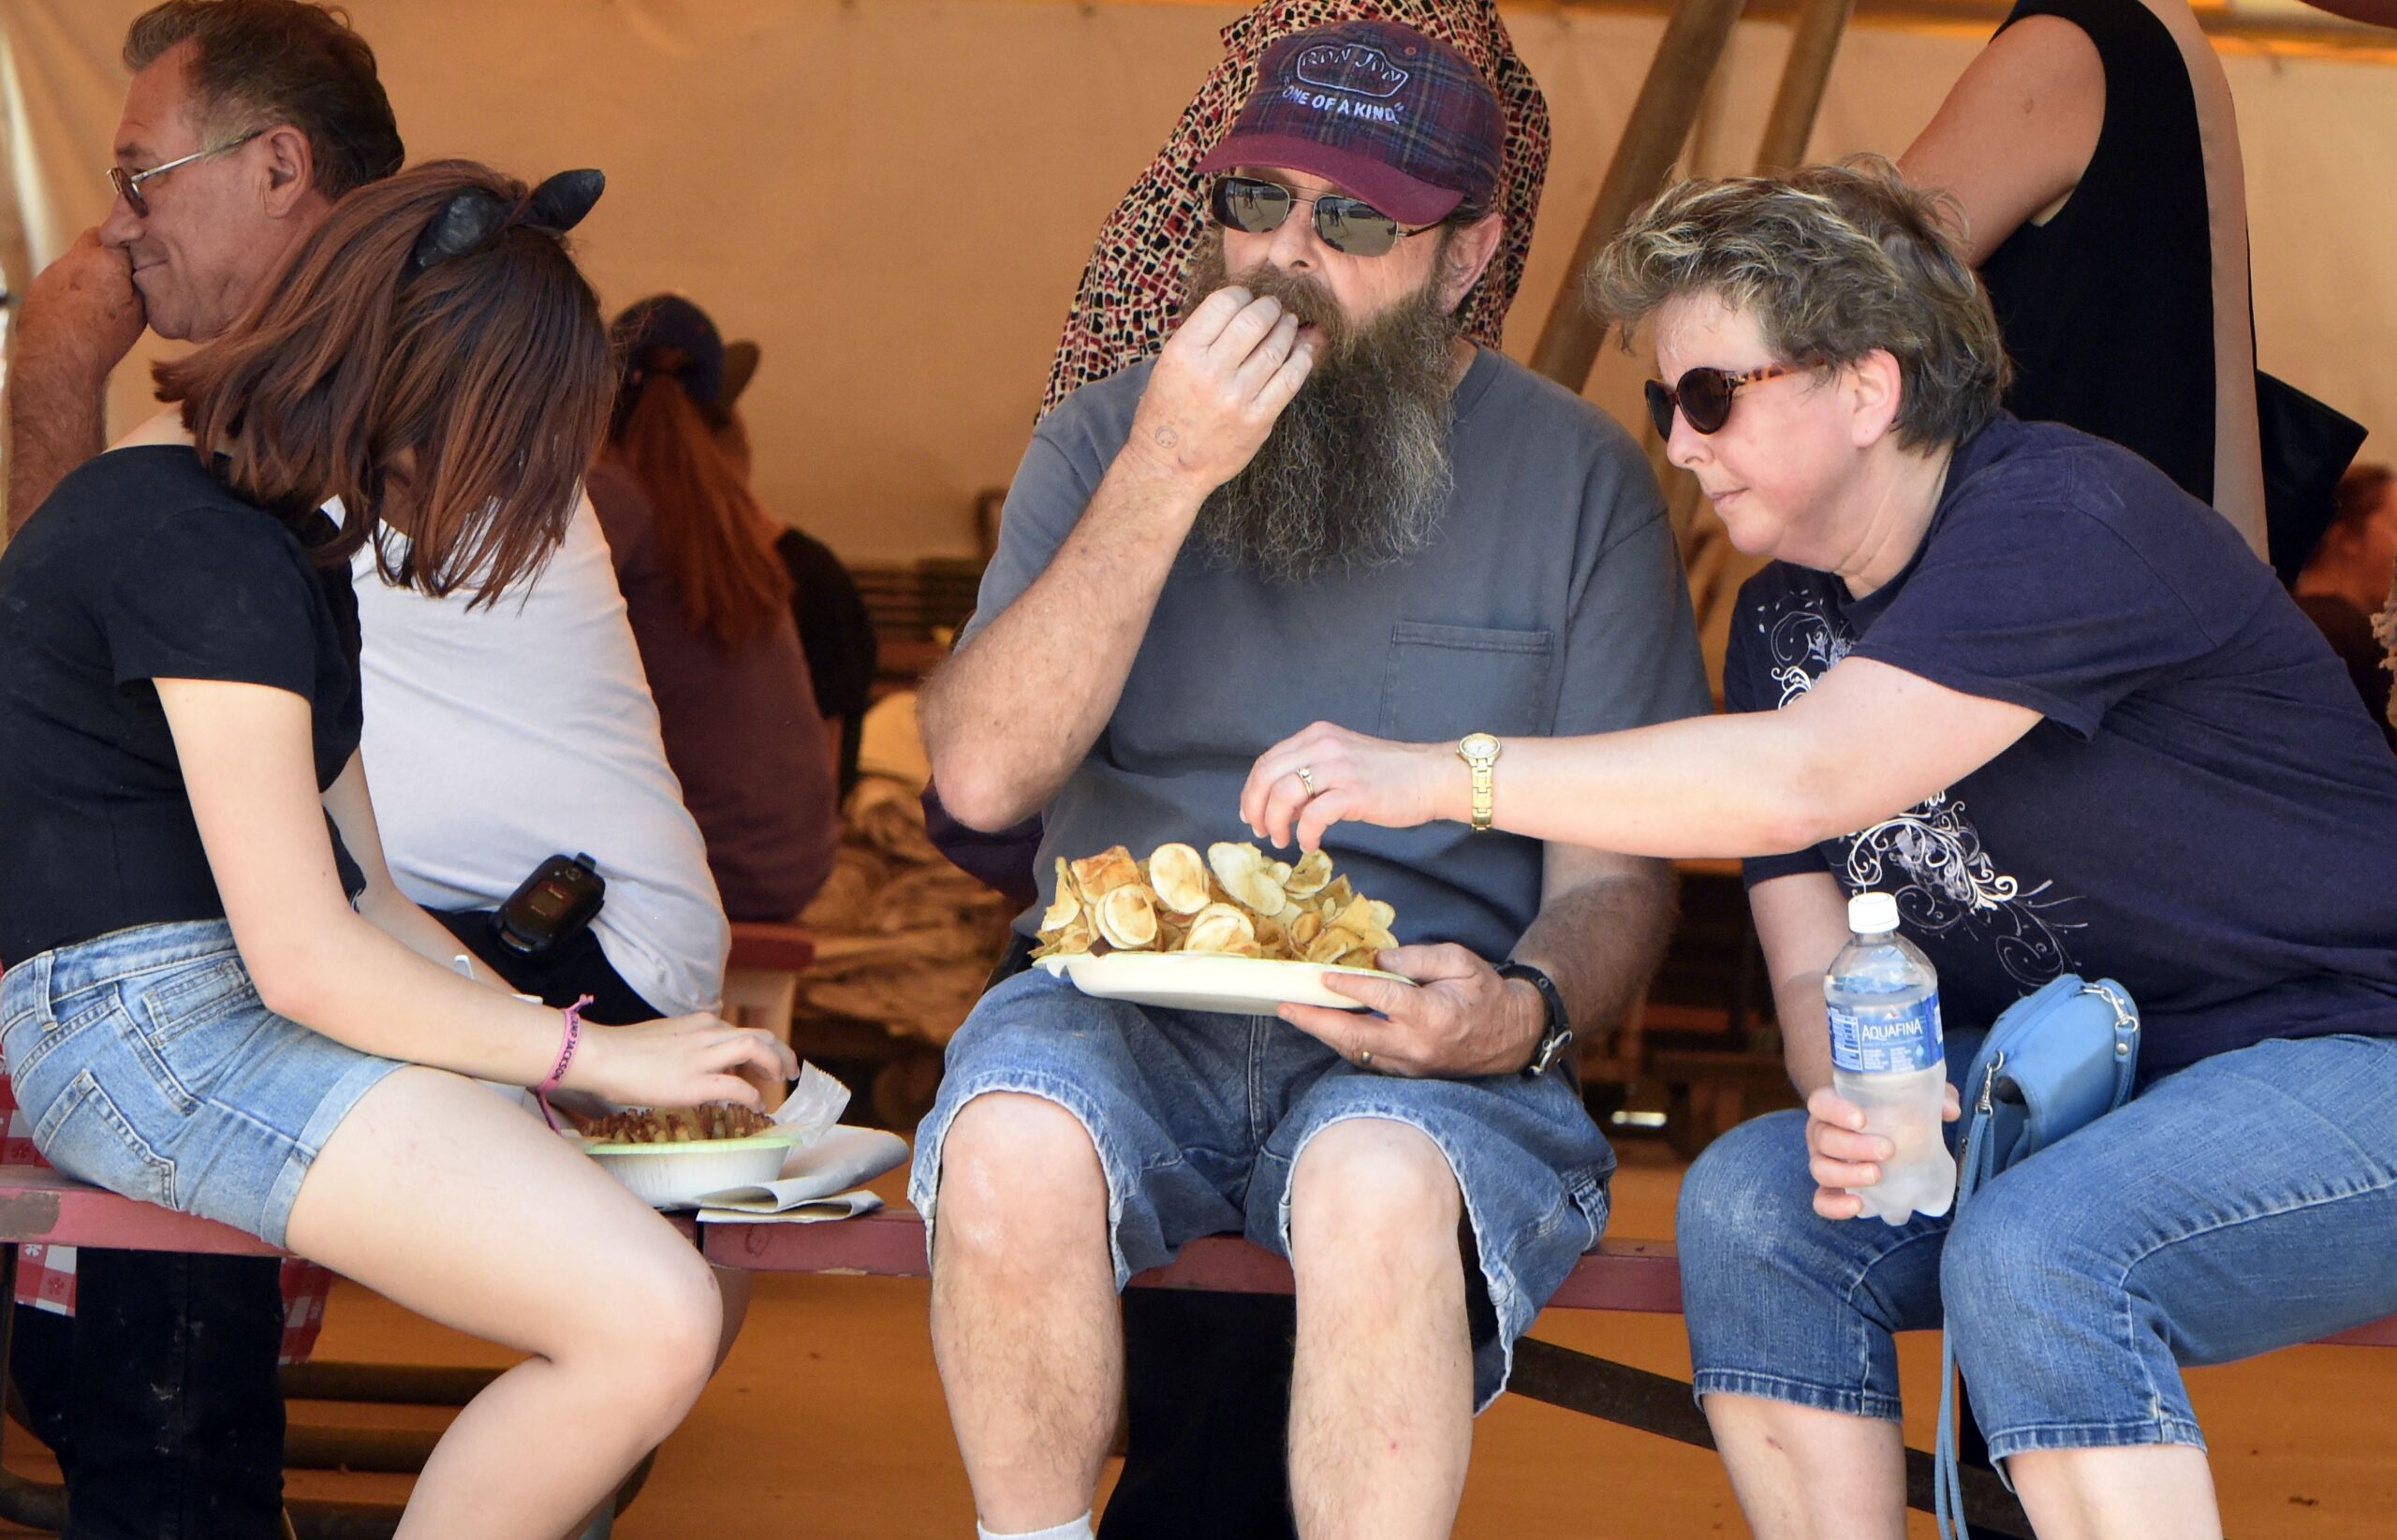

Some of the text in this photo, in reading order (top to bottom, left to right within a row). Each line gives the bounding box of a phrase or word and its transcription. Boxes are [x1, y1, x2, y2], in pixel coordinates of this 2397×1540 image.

[1312, 95, 1336, 111] OF
[1337, 100, 1349, 115] A
[1861, 1018, 1923, 1041] AQUAFINA
[552, 1038, 576, 1080] JACKSON
